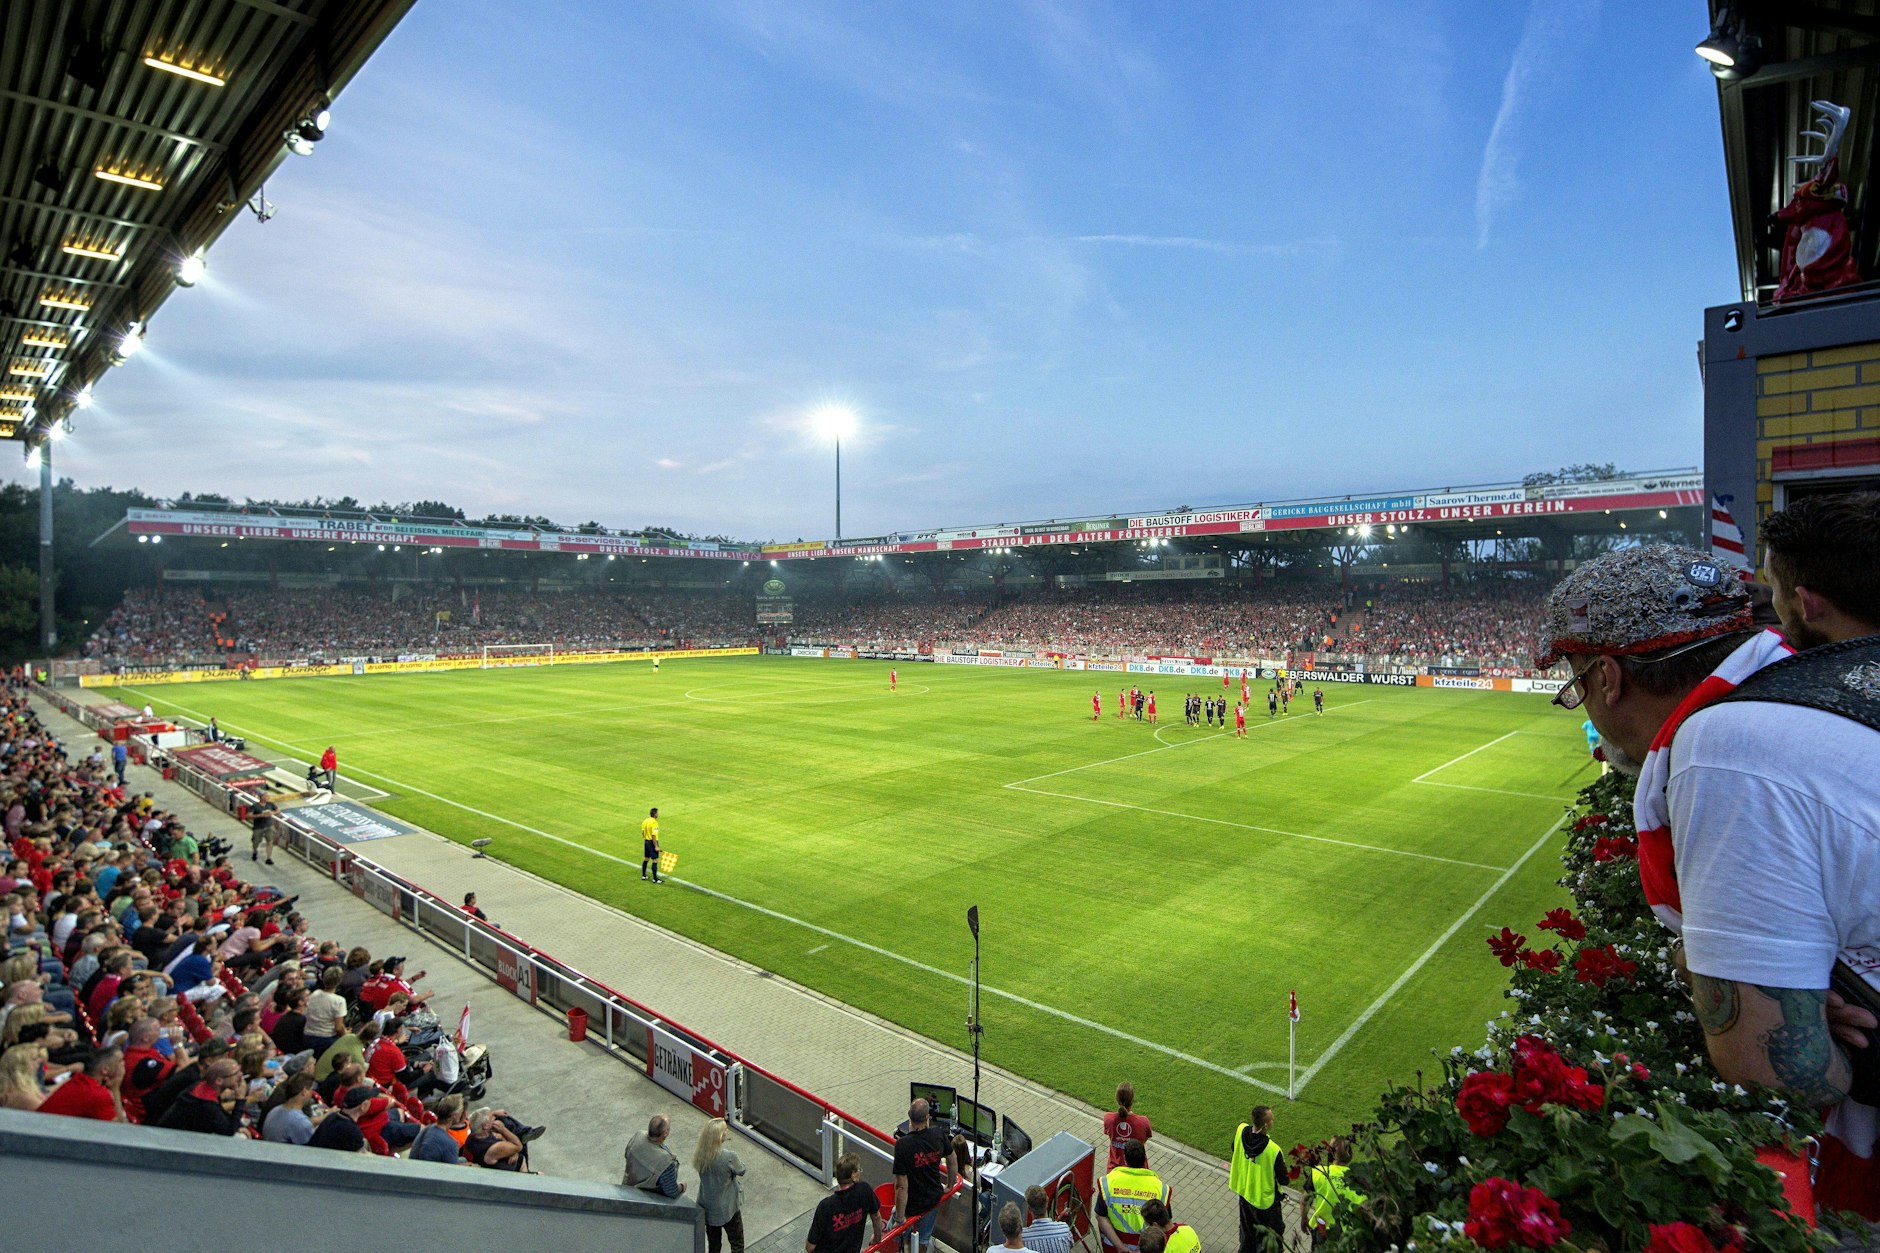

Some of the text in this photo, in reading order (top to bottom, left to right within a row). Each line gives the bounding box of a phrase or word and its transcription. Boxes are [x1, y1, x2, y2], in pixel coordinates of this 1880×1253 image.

[1660, 479, 1704, 488] Wernec
[1430, 492, 1522, 506] SaarowTherme.de
[1272, 508, 1306, 516] GERICKE
[1308, 502, 1388, 514] BAUGESELLSCHAFT
[1328, 500, 1574, 525] UNSER STOLZ. UNSER VEREIN.
[318, 520, 372, 531] TRABET
[1086, 522, 1109, 531] BERLINER
[1130, 512, 1250, 528] DIE BAUSTOFF LOGISTIKER
[182, 524, 419, 543] UNSERE LIEBE. UNSERE MANNSCHAFT.
[982, 526, 1186, 547] STADION AN DER ALTEN FÖRSTEREI
[558, 536, 637, 546] se-services.eu
[858, 545, 903, 554] MANNSCHAFT.
[1285, 671, 1414, 685] EBERSWALDER WURST
[1435, 677, 1492, 688] kfzteile24
[498, 960, 531, 989] BLOCK A1
[655, 1044, 693, 1087] GETRÄNKE
